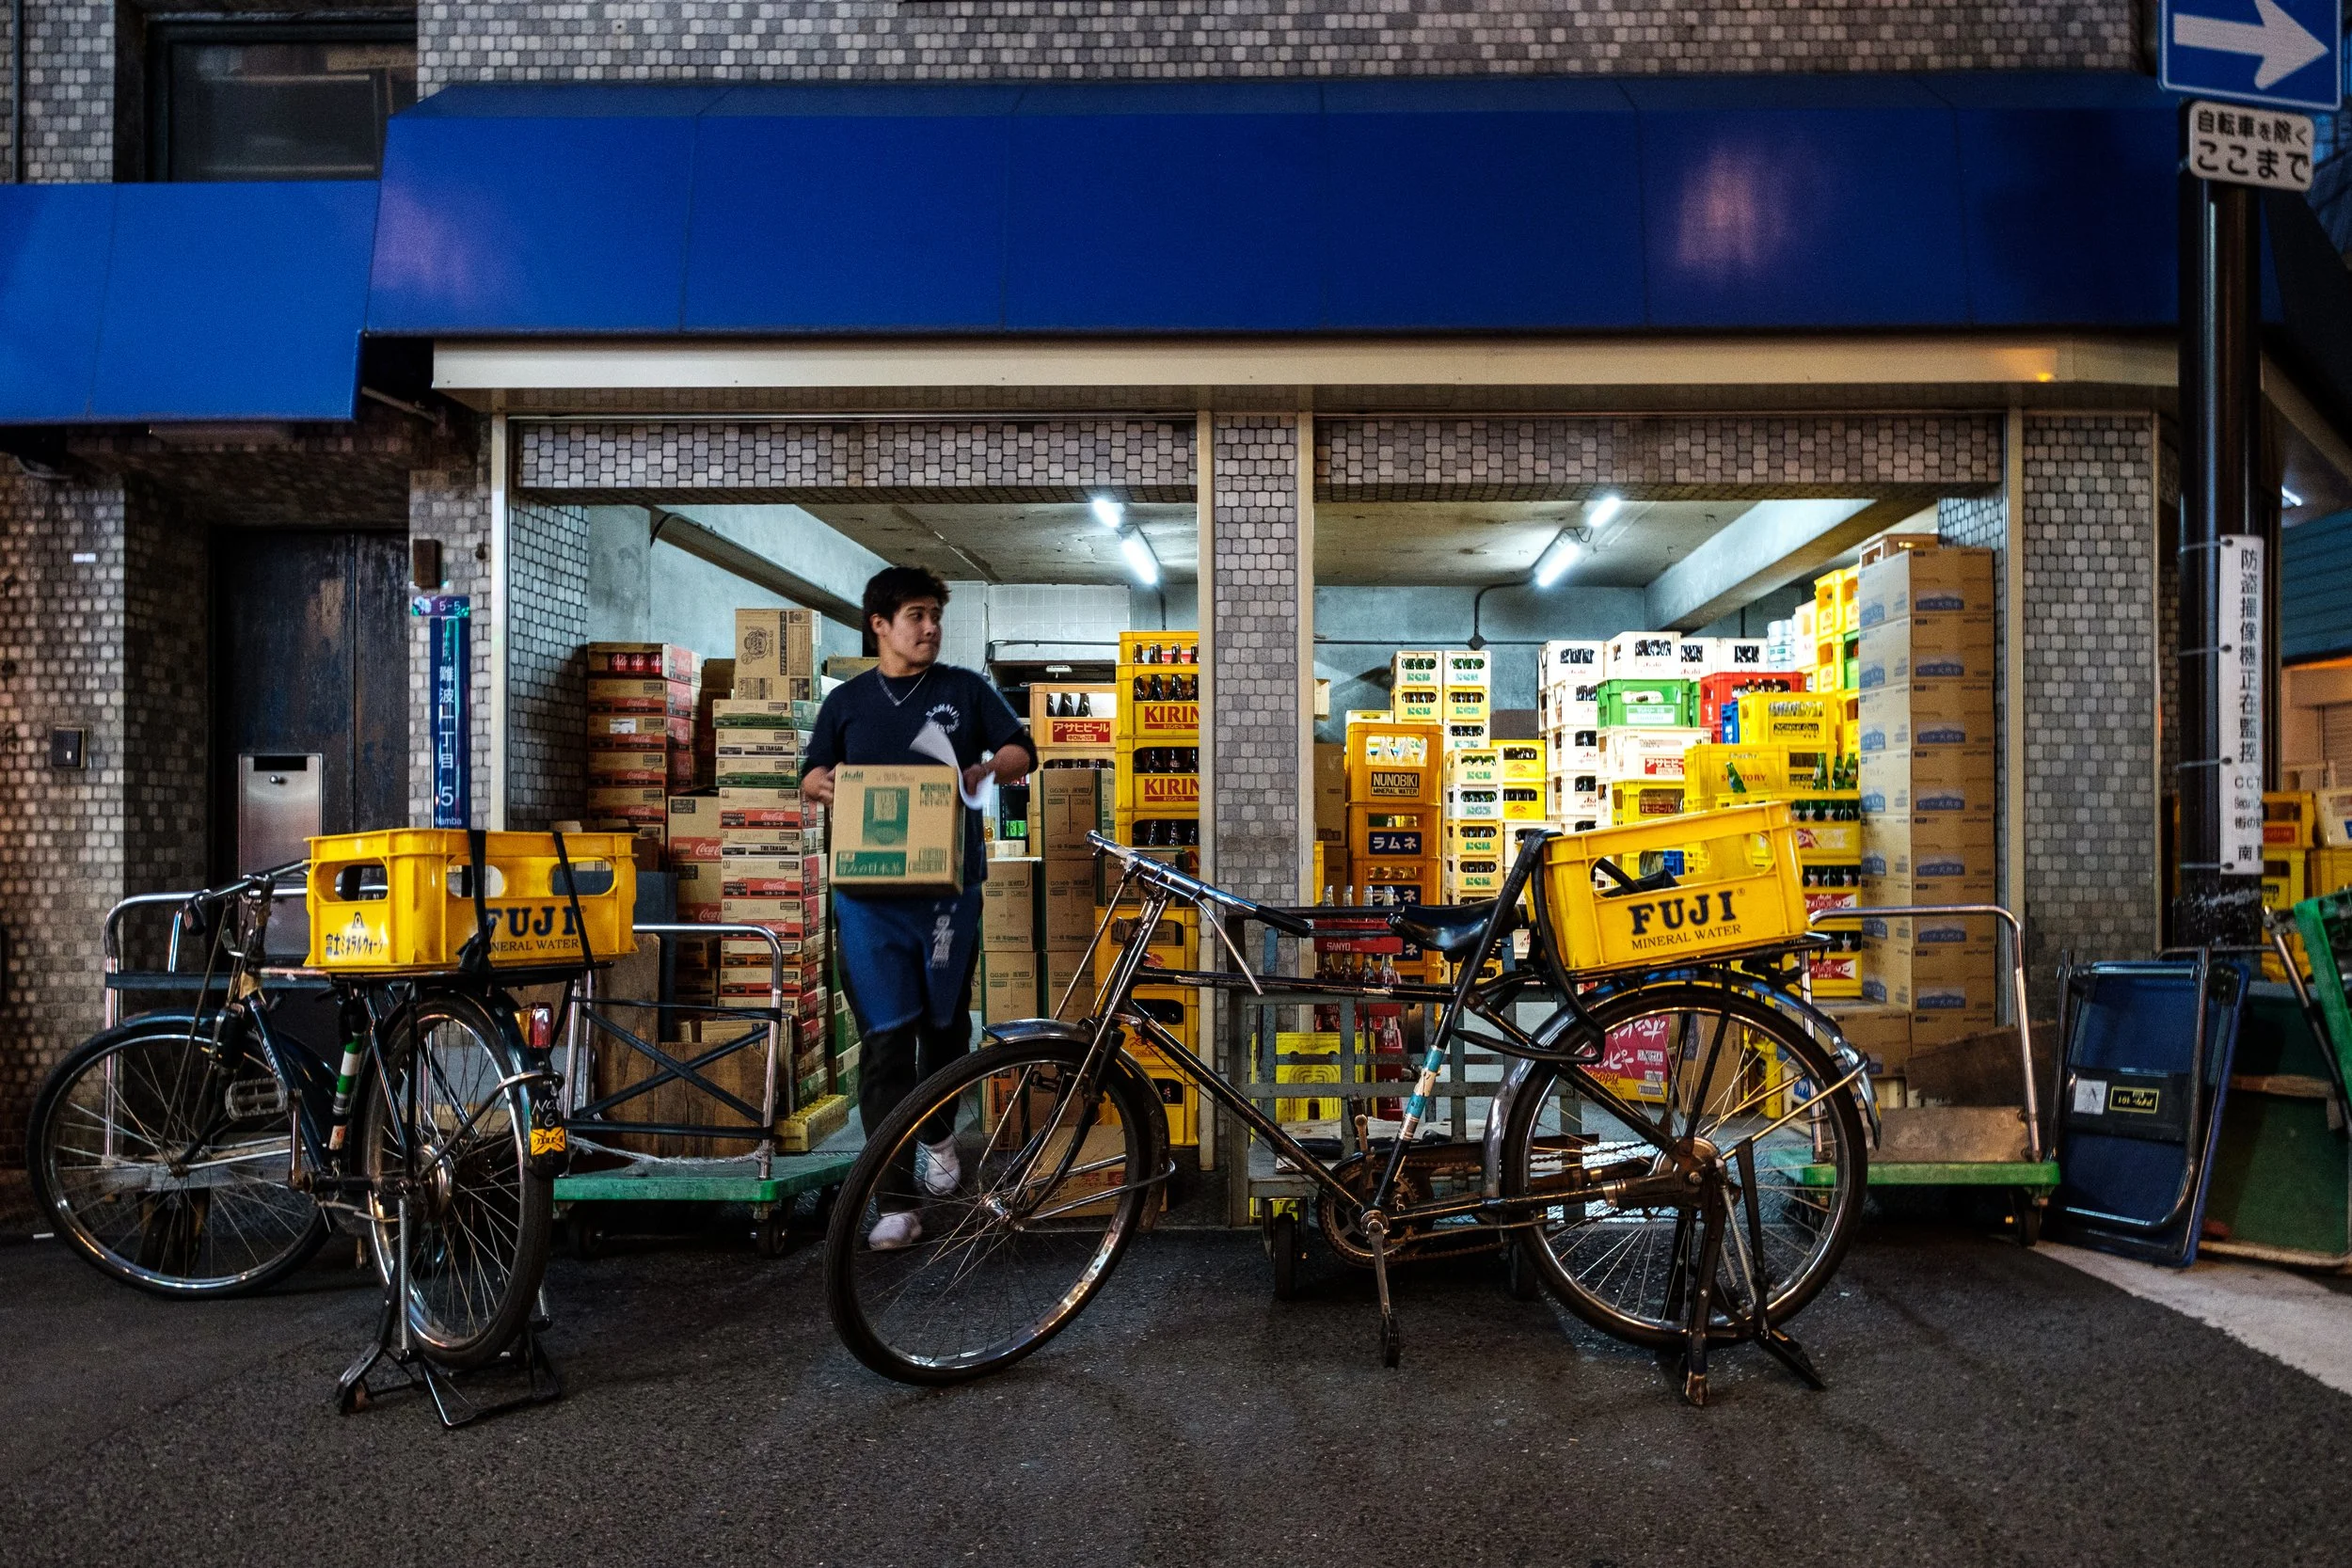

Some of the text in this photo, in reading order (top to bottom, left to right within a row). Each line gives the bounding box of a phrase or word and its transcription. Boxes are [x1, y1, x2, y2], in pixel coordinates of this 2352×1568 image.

[2197, 110, 2307, 145] 自転車を除く
[2197, 140, 2310, 183] ここまで
[439, 601, 461, 611] 5-5
[438, 665, 455, 769] 難波一丁目
[1054, 722, 1109, 733] アサヒビール
[1646, 759, 1684, 768] アサヒビー
[1373, 773, 1418, 787] NUNOBIKI
[1722, 773, 1767, 782] STORY
[2234, 775, 2262, 788] CCT
[440, 786, 454, 807] 5
[435, 816, 462, 826] Namba
[760, 811, 785, 820] Coca-Cola
[1373, 836, 1417, 849] ラムネ
[696, 843, 722, 856] Coca-
[763, 881, 787, 890] Coca-Cola
[1629, 891, 1737, 935] FUJI
[1631, 924, 1742, 951] MINERAL WATER
[326, 933, 387, 957] 富士ミネラルウォータ
[490, 939, 580, 952] NERAL WATER
[1327, 942, 1351, 951] SANYO
[544, 1113, 555, 1127] 6
